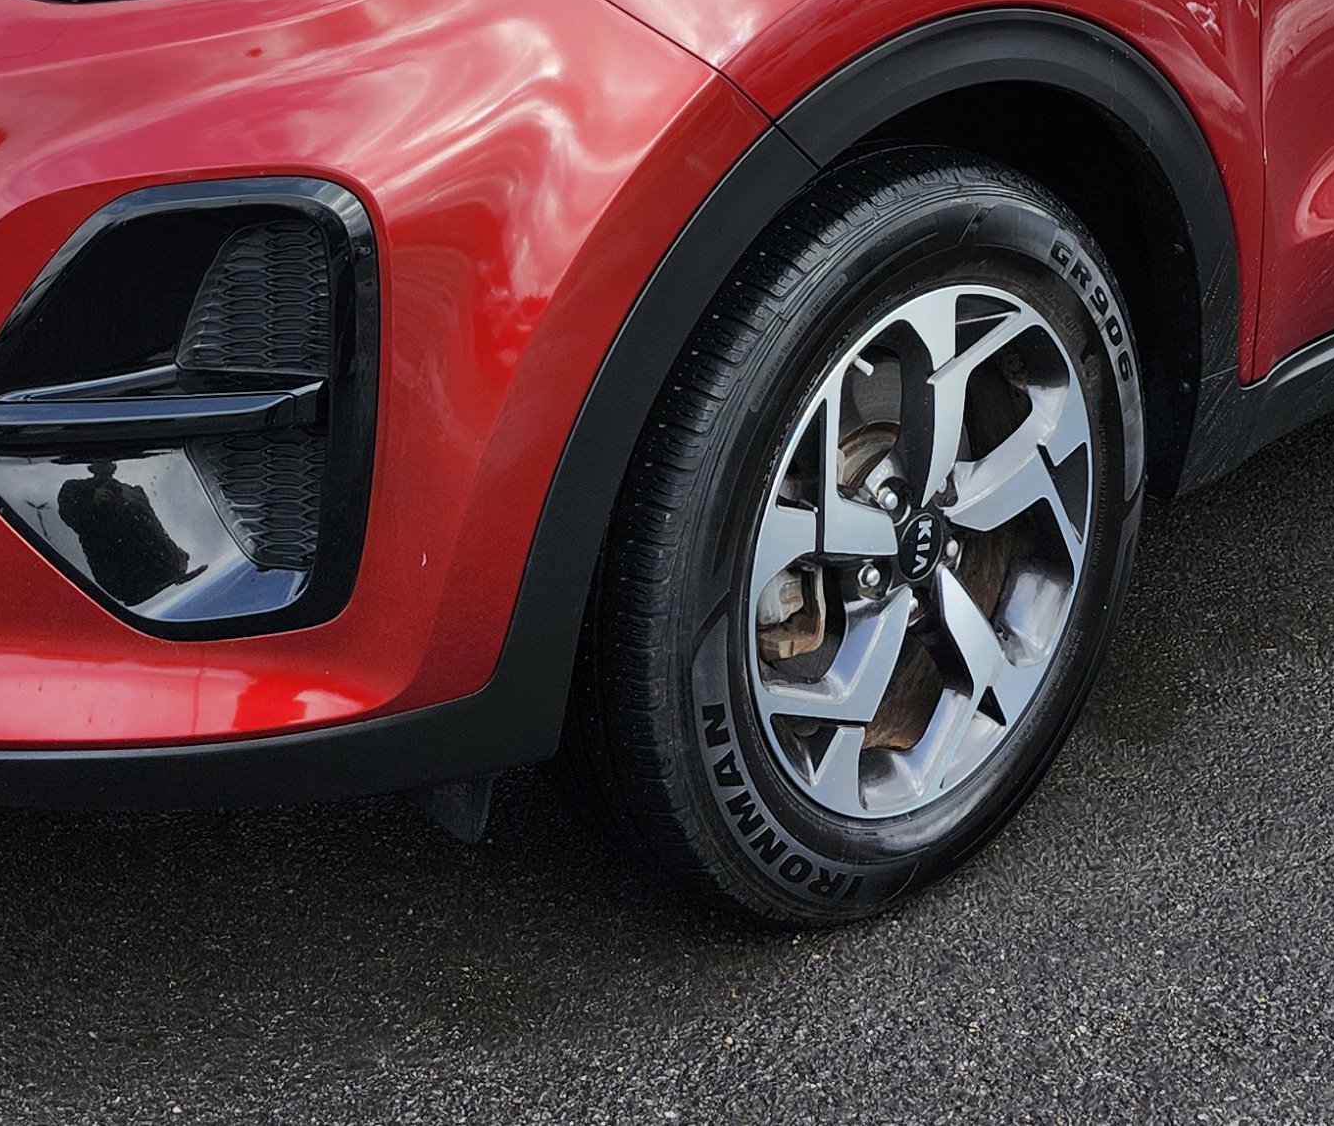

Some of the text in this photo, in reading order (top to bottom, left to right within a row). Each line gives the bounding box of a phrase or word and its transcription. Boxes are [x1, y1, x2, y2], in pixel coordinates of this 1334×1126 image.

[1049, 239, 1134, 383] GR906
[911, 518, 933, 575] KIA
[701, 702, 866, 900] IRONMAN
